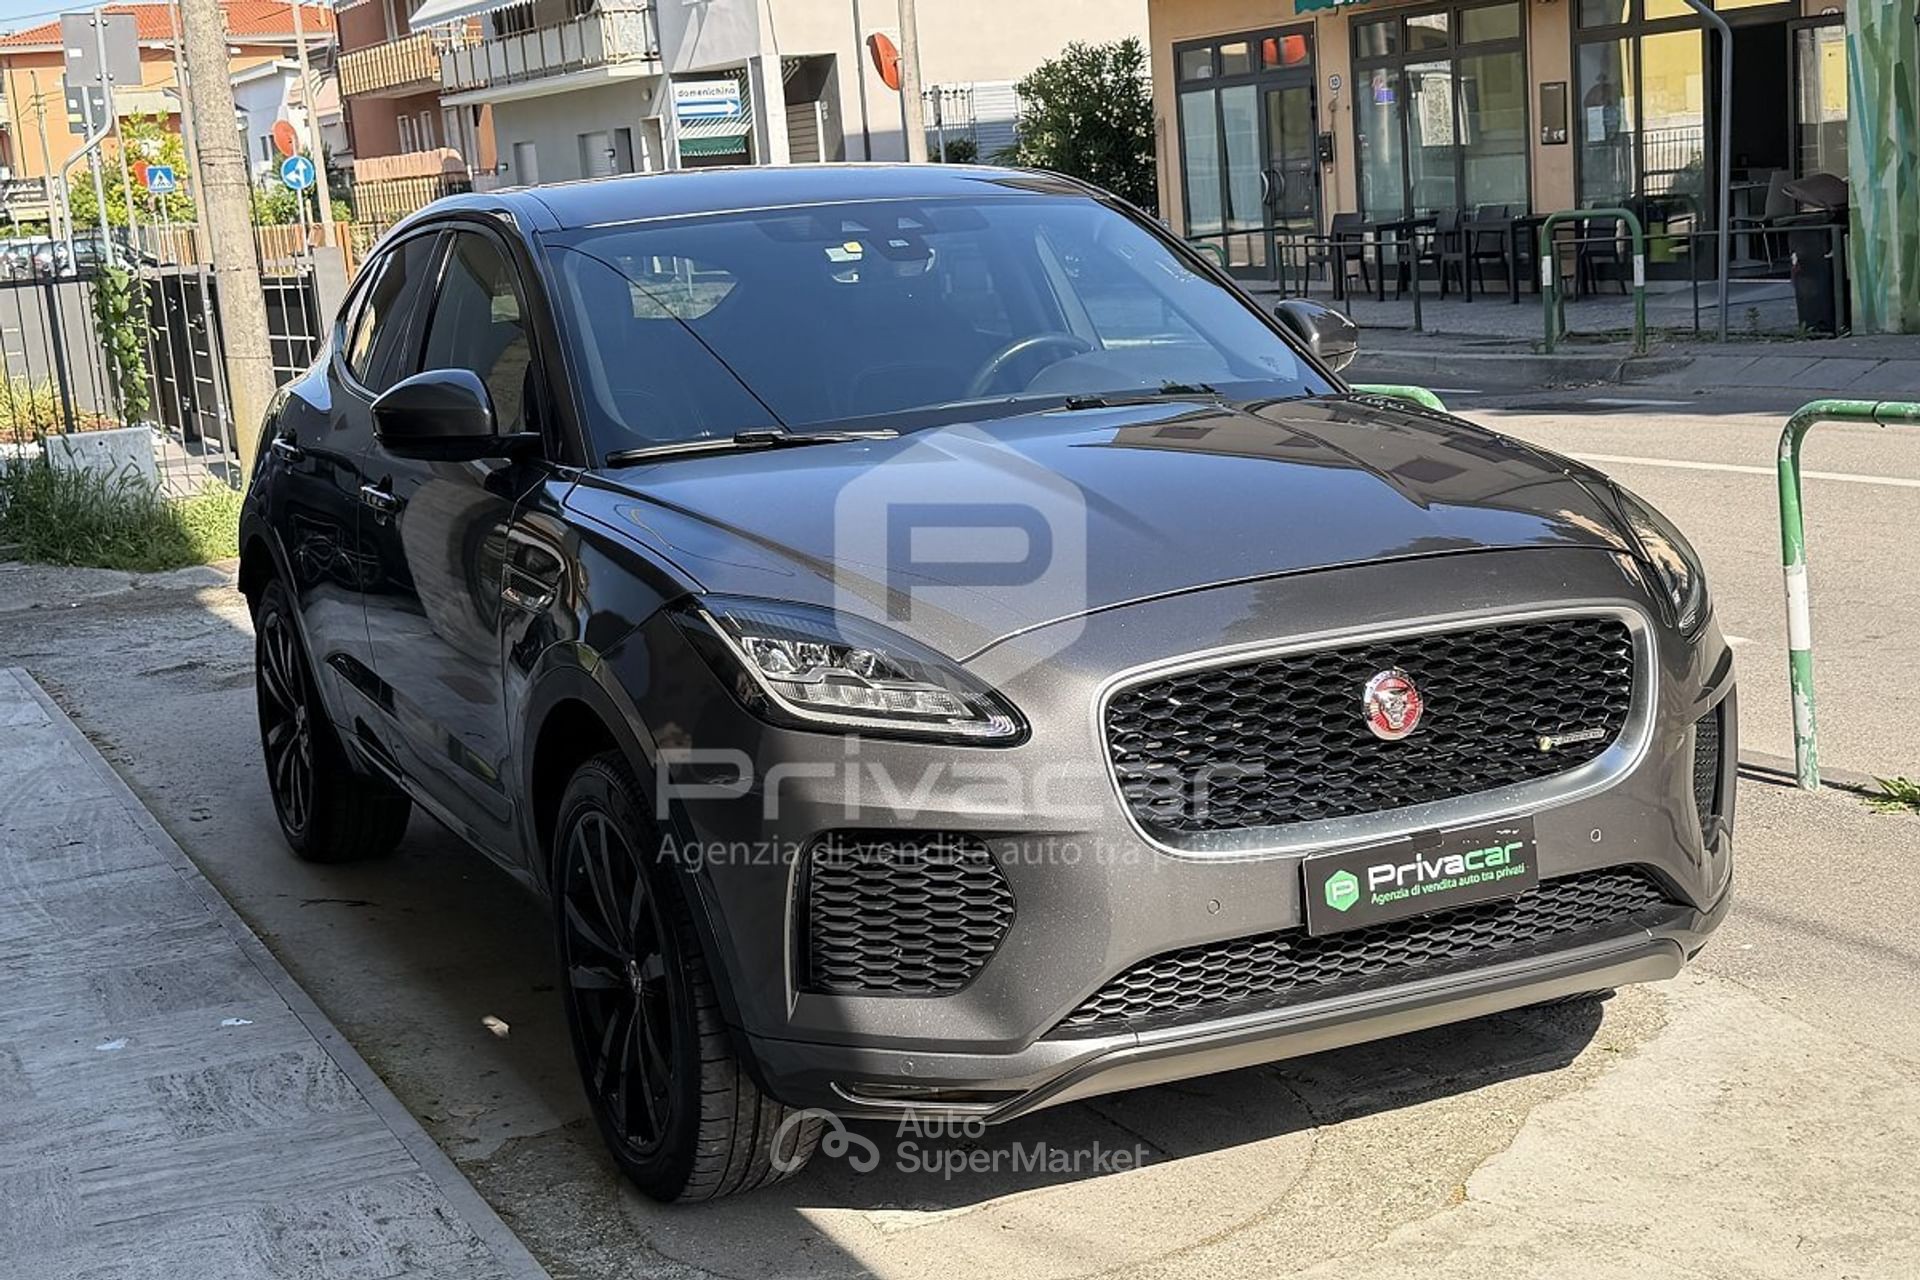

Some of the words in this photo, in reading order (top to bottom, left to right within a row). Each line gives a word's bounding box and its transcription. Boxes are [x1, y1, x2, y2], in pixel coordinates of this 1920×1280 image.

[1368, 841, 1523, 891] Privacar
[1371, 888, 1409, 905] Agenzia
[1411, 883, 1421, 896] di
[1422, 878, 1458, 895] vendita
[1458, 874, 1479, 887] auto
[1480, 870, 1494, 882] tra
[1496, 864, 1525, 882] privati
